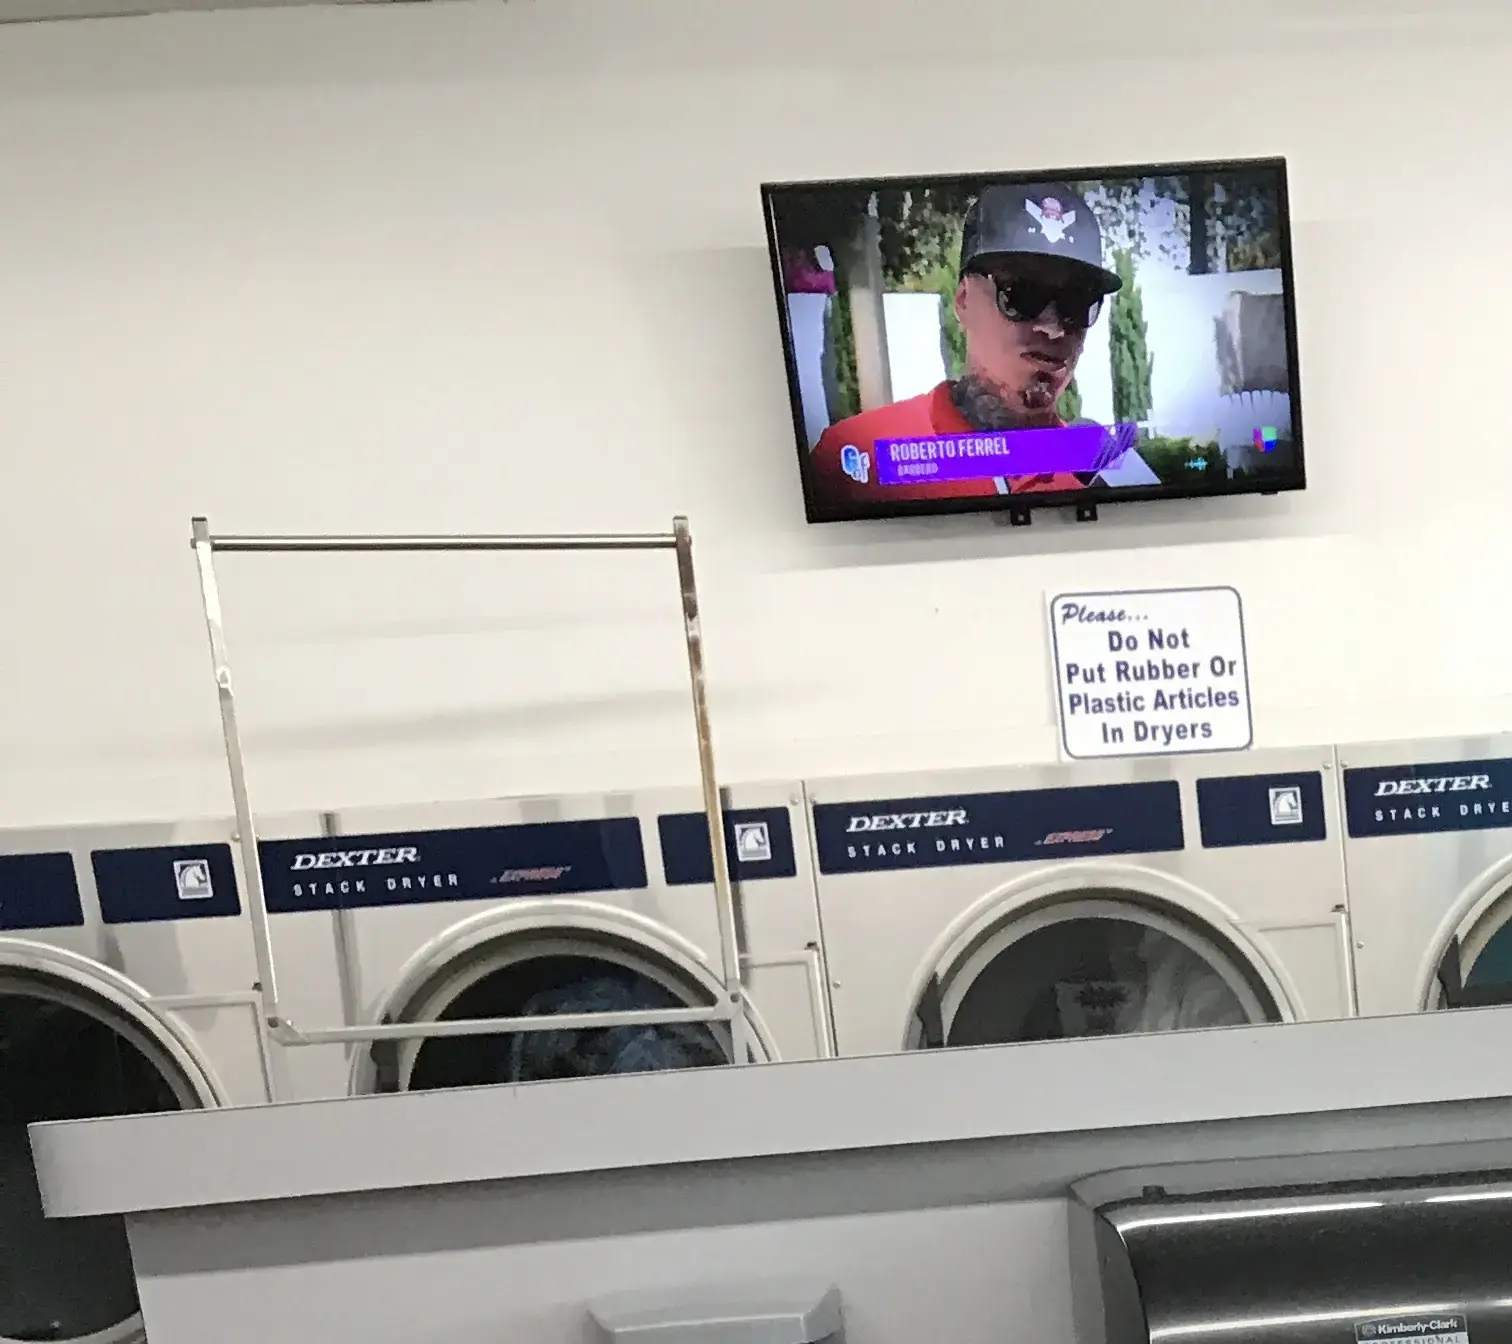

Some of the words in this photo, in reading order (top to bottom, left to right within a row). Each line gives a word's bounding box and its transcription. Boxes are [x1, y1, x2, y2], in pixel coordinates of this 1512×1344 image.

[890, 439, 956, 462] ROBERTO
[958, 436, 1010, 458] FERREL
[1108, 630, 1138, 652] Do
[1148, 628, 1190, 650] Not
[1066, 663, 1106, 684] Put
[1116, 659, 1200, 682] Rubber
[1210, 656, 1236, 677] Or
[1068, 691, 1145, 714] Plastic
[1153, 687, 1239, 710] Articles
[1102, 723, 1123, 743] In
[1134, 721, 1212, 746] Dryers
[1374, 774, 1491, 797] DEXTER
[846, 809, 968, 833] DEXTER
[1375, 806, 1440, 822] STACK
[291, 846, 419, 870] DEXTER
[848, 841, 916, 859] STACK
[936, 835, 1004, 852] DRYER
[293, 878, 366, 897] STACK
[387, 873, 458, 891] DRYER
[1378, 1319, 1457, 1335] Kimberly-Clark
